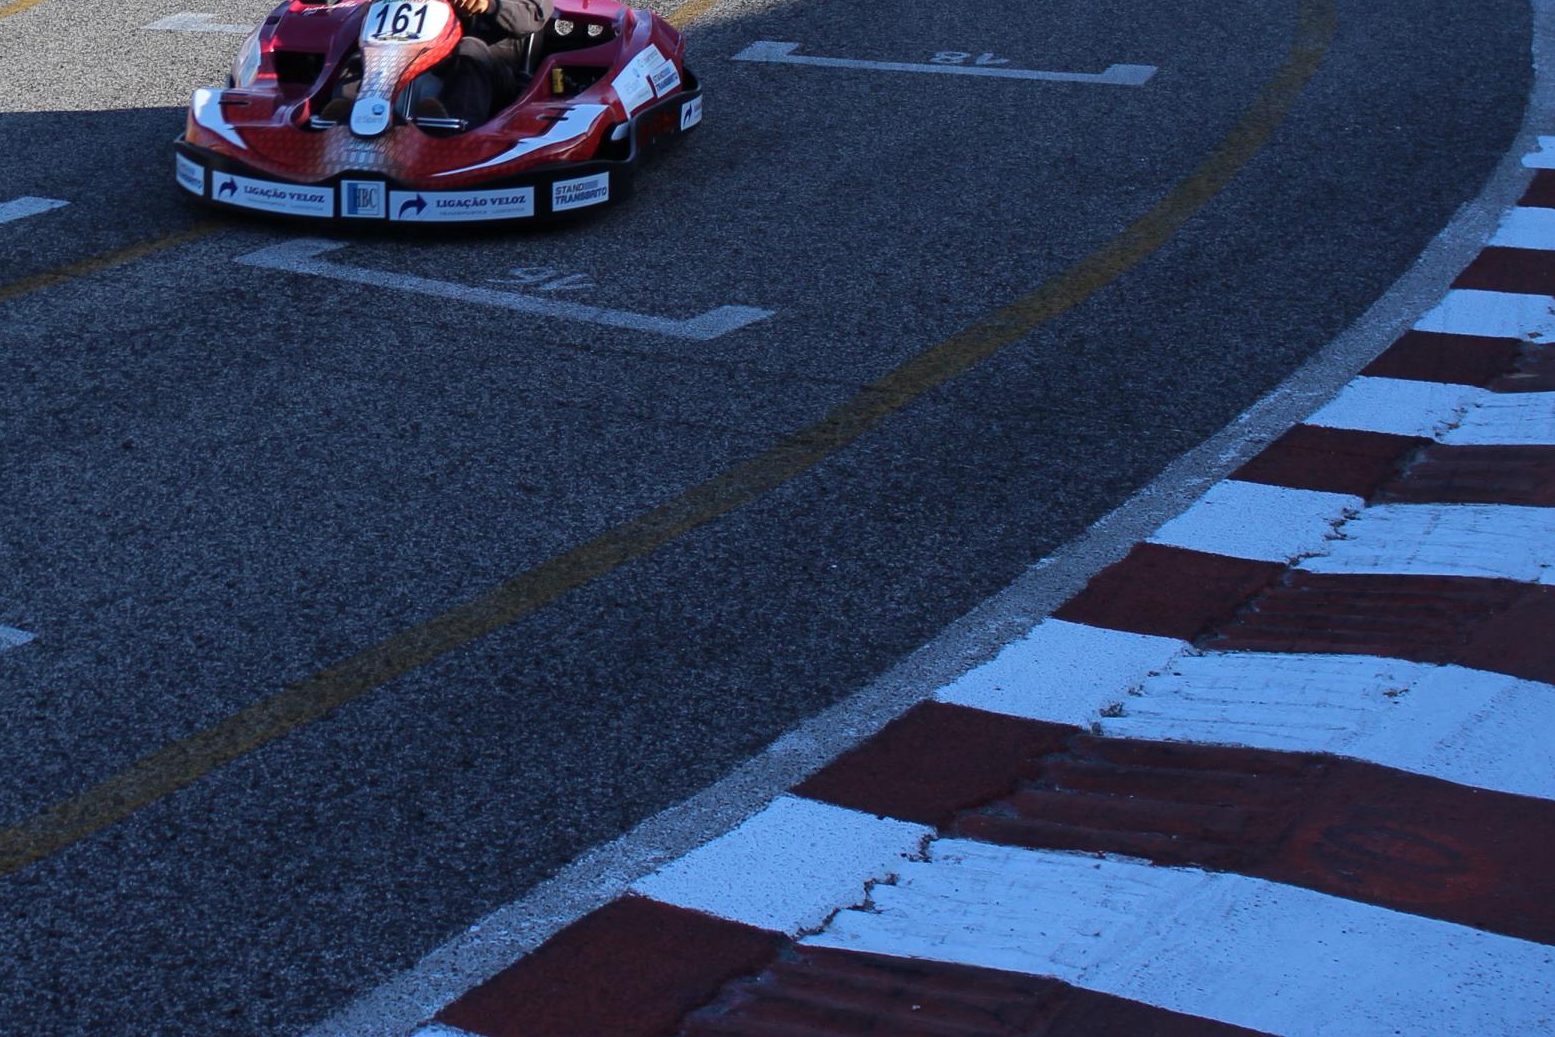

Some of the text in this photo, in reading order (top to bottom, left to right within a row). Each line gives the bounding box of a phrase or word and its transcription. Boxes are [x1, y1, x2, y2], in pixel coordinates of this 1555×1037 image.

[376, 3, 428, 34] 161
[288, 192, 326, 204] VELOZ
[435, 195, 526, 209] LIGAÇÃO VELOZ
